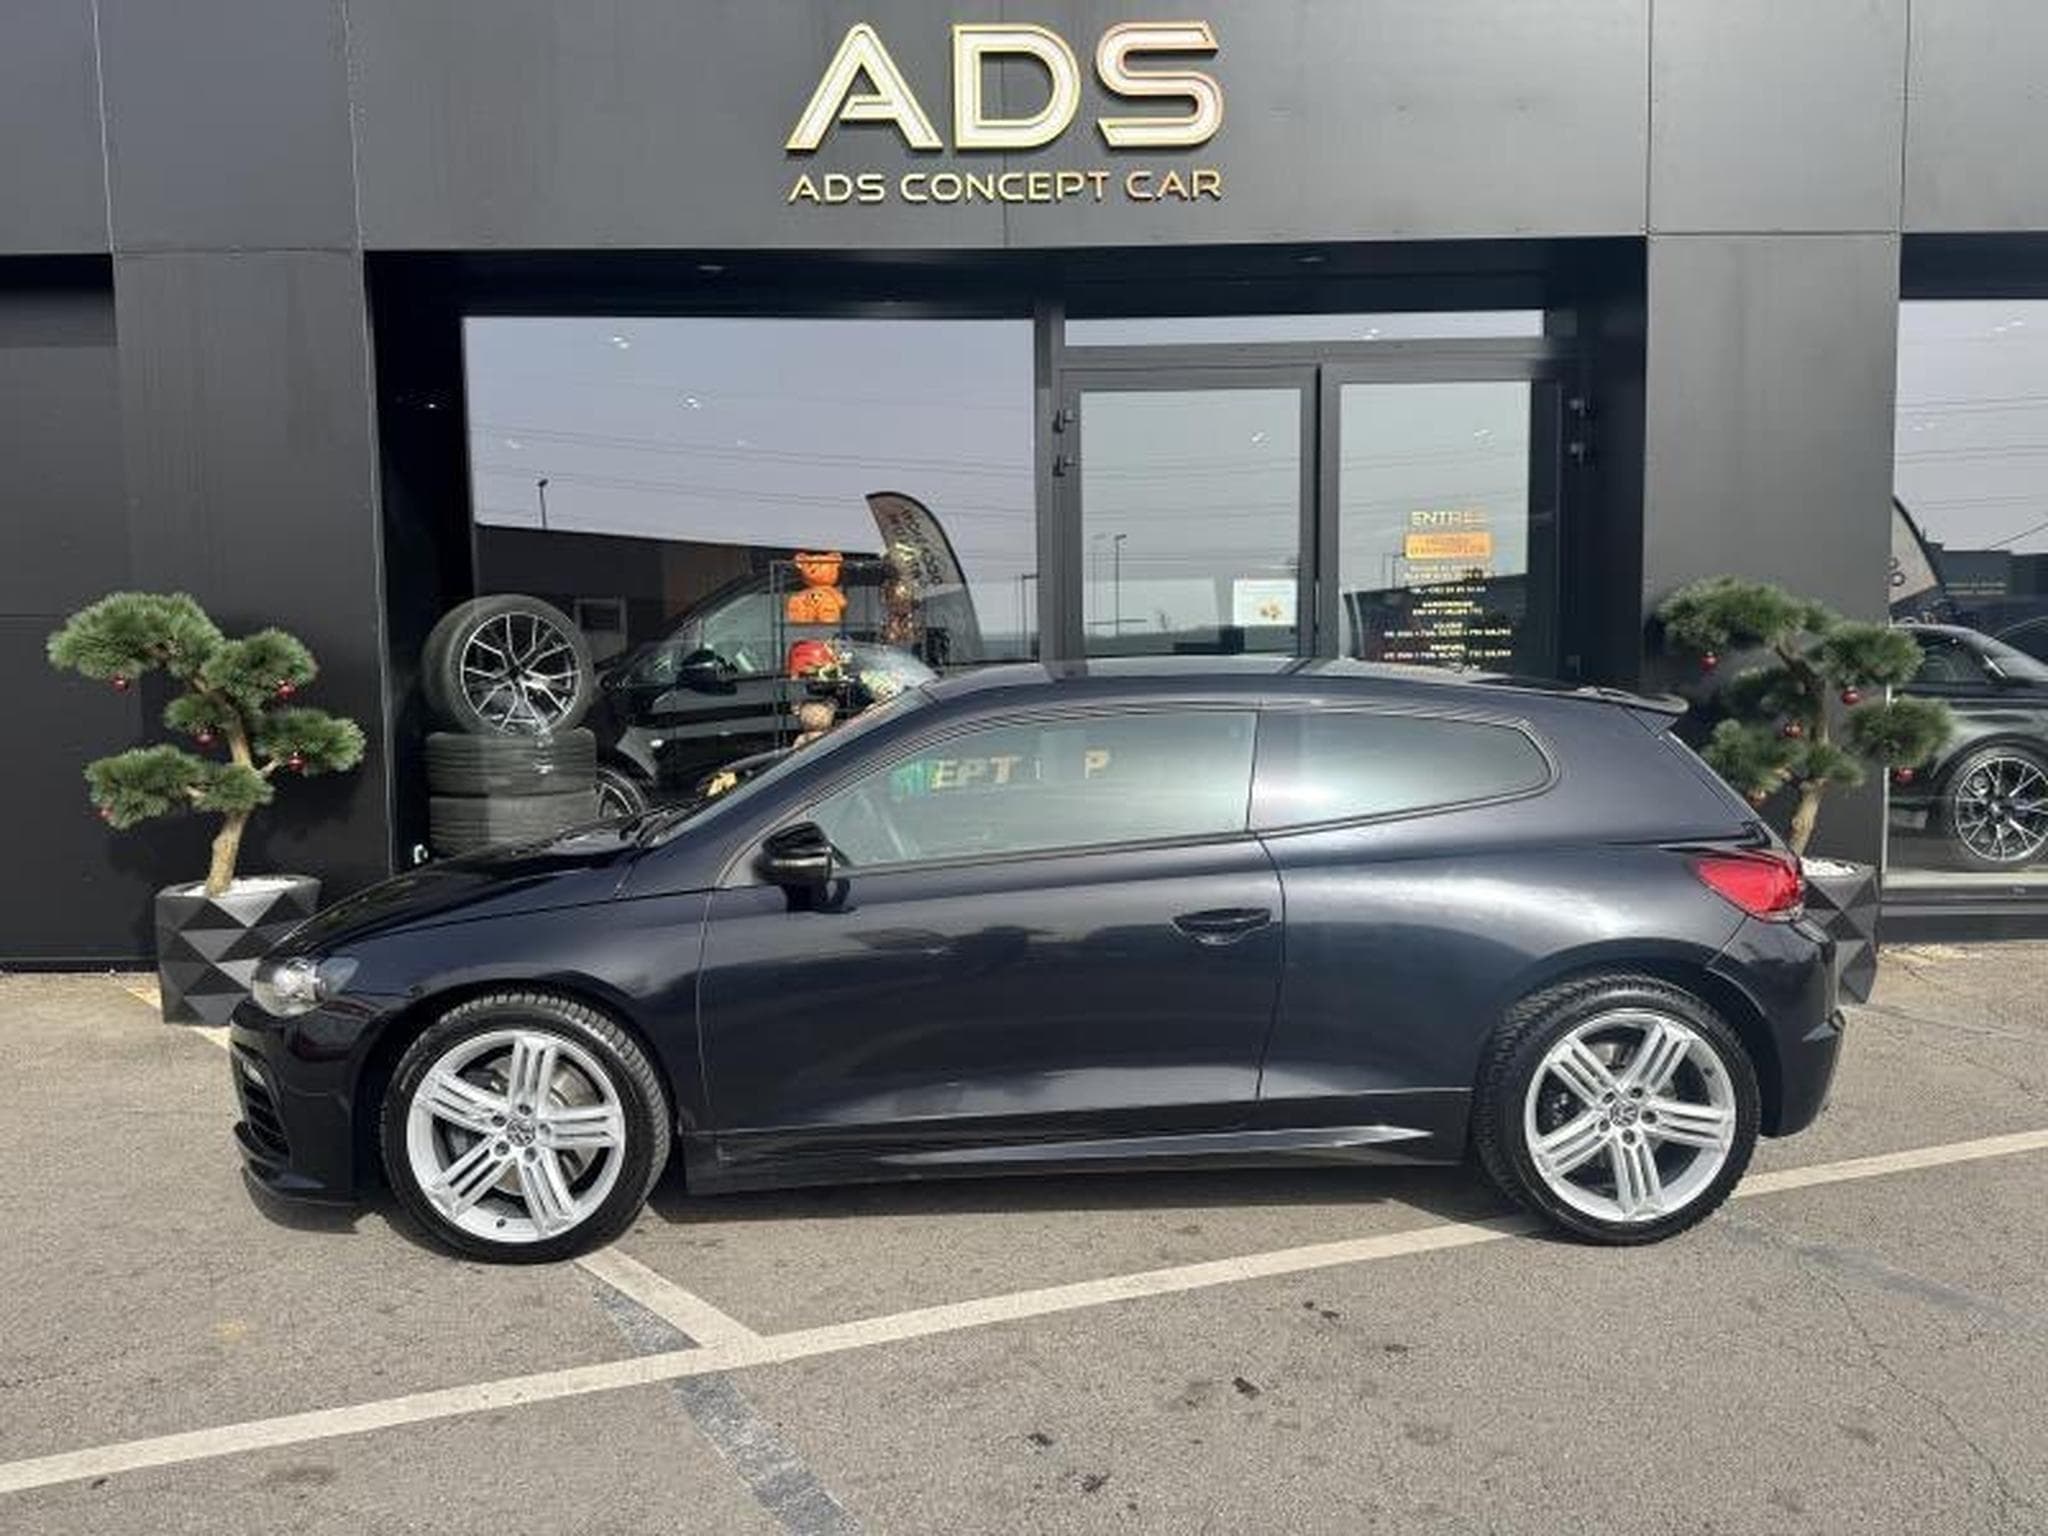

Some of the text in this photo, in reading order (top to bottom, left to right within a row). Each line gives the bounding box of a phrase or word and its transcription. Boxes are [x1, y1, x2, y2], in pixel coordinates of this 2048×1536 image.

[784, 20, 1224, 151] ADS
[788, 169, 1223, 202] ADS CONCEPT CAR
